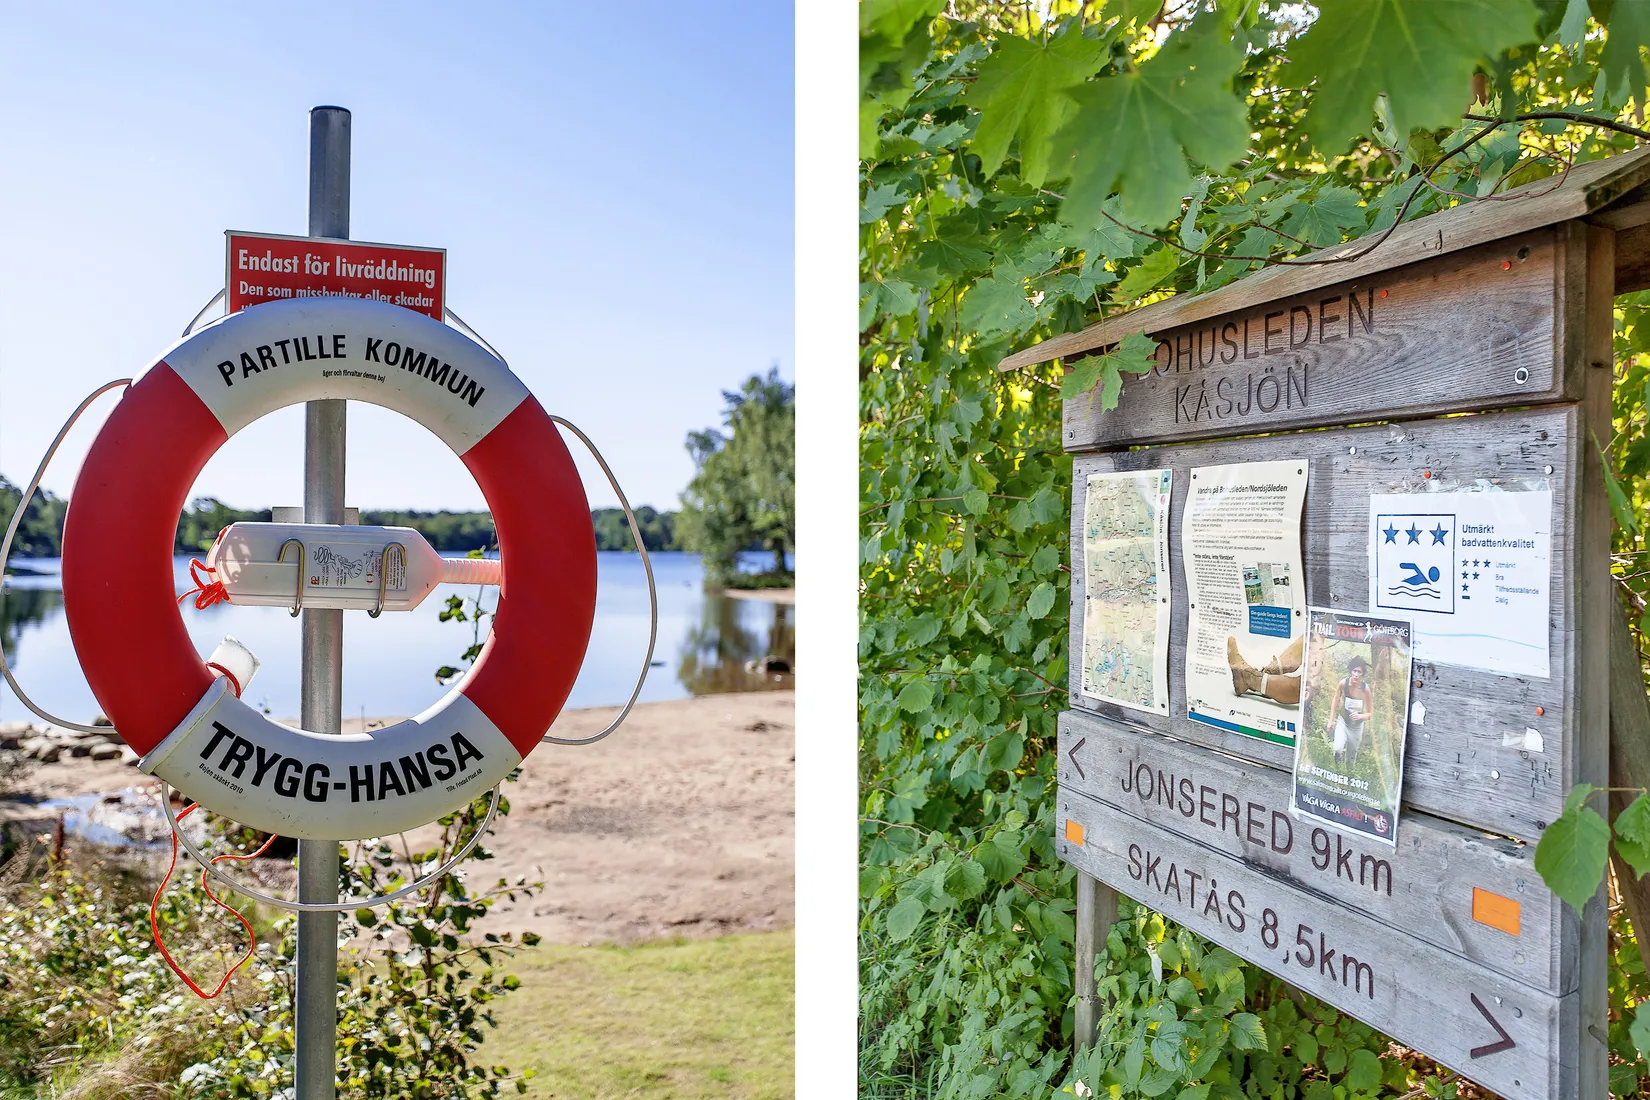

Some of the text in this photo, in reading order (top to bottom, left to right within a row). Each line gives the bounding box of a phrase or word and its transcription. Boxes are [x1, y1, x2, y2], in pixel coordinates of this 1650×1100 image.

[238, 249, 436, 289] Endast för livräddning
[239, 280, 264, 296] Den
[267, 286, 292, 298] som
[365, 289, 392, 303] eller
[394, 291, 435, 308] skadar
[1136, 287, 1375, 380] OHUSLEDEN
[217, 334, 485, 408] PARTILLE KOMMUN
[1175, 363, 1309, 424] KÅSJÖN
[1461, 537, 1535, 548] badvattenkvalitet
[1462, 524, 1495, 534] Utmärkt
[198, 762, 244, 795] Bojen skänkt 2010
[199, 721, 485, 803] TRYGG-HANSA
[1311, 765, 1349, 786] SEPTEMBER
[1350, 778, 1369, 791] 2012
[1302, 793, 1319, 807] VÅGA
[1121, 760, 1392, 896] JONSERED 9km
[1127, 843, 1374, 999] SKATÅS 8,5km
